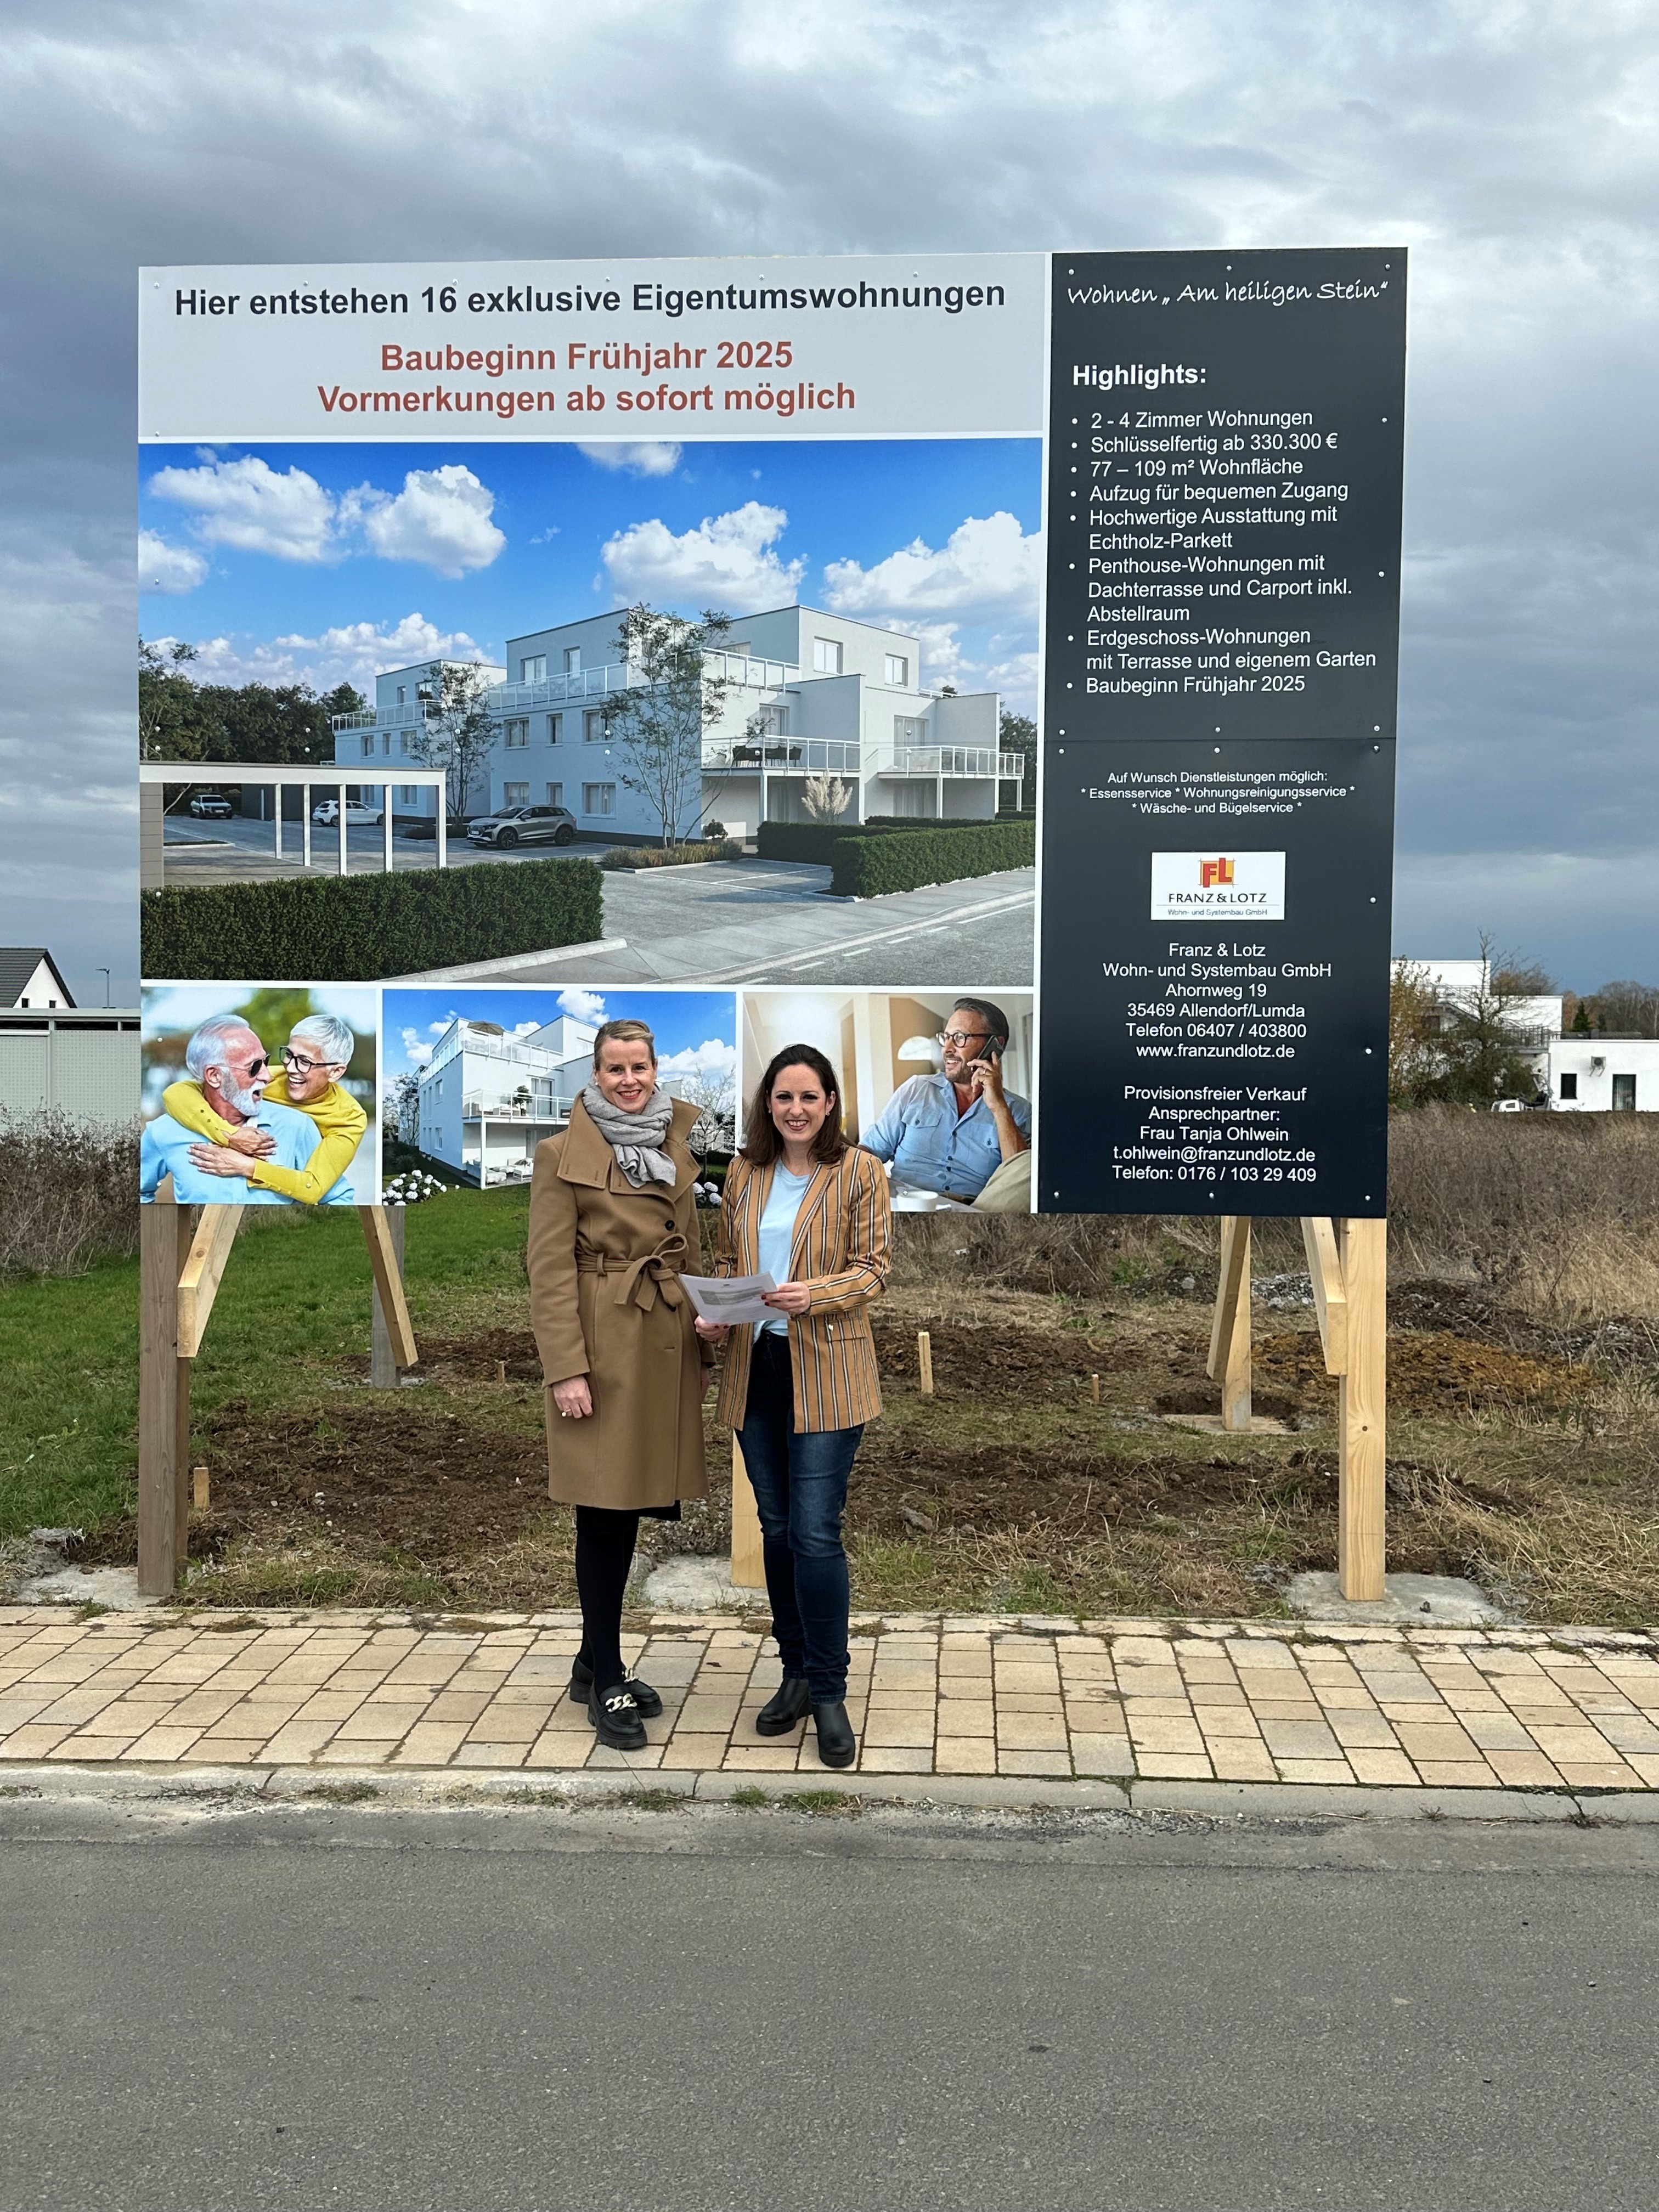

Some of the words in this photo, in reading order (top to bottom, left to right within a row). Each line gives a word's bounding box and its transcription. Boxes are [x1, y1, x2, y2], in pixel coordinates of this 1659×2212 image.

[177, 290, 240, 315] Hier
[250, 288, 408, 314] entstehen
[422, 287, 456, 312] 16
[469, 285, 620, 312] exklusive
[634, 281, 1004, 317] Eigentumswohnungen
[1068, 285, 1157, 303] Wohnen
[1177, 285, 1218, 301] Am
[1226, 281, 1312, 306] heiligen
[382, 344, 555, 377] Baubeginn
[569, 342, 707, 376] Frühjahr
[717, 342, 792, 368] 2025
[1074, 364, 1205, 390] Highlights:
[318, 386, 554, 418] Vormerkungen
[567, 385, 605, 411] ab
[617, 384, 713, 410] sofort
[725, 382, 854, 416] möglich
[1092, 413, 1101, 428] 2
[1119, 413, 1130, 427] 4
[1136, 412, 1203, 427] Zimmer
[1207, 410, 1312, 429] Wohnungen
[1091, 435, 1217, 454] Schlüsselfertig
[1223, 435, 1244, 450] ab
[1251, 433, 1321, 450] 330.300
[1326, 433, 1338, 448] €
[1091, 462, 1111, 477] 77
[1135, 460, 1166, 476] 109
[1172, 460, 1194, 475] m²
[1200, 458, 1302, 475] Wohnfläche
[1090, 485, 1150, 504] Aufzug
[1156, 484, 1179, 500] für
[1185, 484, 1276, 503] bequemen
[1282, 482, 1347, 501] Zugang
[1091, 509, 1197, 528] Hochwertige
[1201, 507, 1305, 526] Ausstattung
[1312, 506, 1337, 521] mit
[1090, 532, 1232, 549] Echtholz-Parkett
[1090, 556, 1292, 575] Penthouse-Wohnungen
[1299, 555, 1324, 570] mit
[1089, 582, 1203, 597] Dachterrasse
[1210, 580, 1240, 596] und
[1247, 580, 1312, 599] Carport
[1318, 578, 1351, 594] inkl.
[1087, 606, 1189, 622] Abstellraum
[1088, 628, 1310, 649] Erdgeschoss-Wohnungen
[1087, 654, 1112, 669] mit
[1118, 654, 1192, 669] Terrasse
[1198, 652, 1229, 668] und
[1235, 652, 1310, 672] eigenem
[1317, 651, 1375, 666] Garten
[1087, 678, 1177, 696] Baubeginn
[1184, 676, 1257, 696] Frühjahr
[1261, 676, 1305, 691] 2025
[1108, 772, 1128, 783] Auf
[1131, 772, 1177, 782] Wunsch
[1181, 772, 1275, 784] Dienstleistungen
[1279, 771, 1327, 783] möglich:
[1090, 788, 1171, 798] Essensservice
[1183, 787, 1346, 799] Wohnungsreinigungsservice
[1140, 803, 1191, 813] Wäsche-
[1195, 803, 1215, 813] und
[1220, 802, 1293, 815] Bügelservice
[1169, 894, 1214, 902] FRANZ
[1217, 894, 1227, 902] &
[1231, 894, 1266, 902] LOTZ
[1170, 943, 1212, 956] Franz
[1217, 943, 1228, 956] &
[1234, 943, 1266, 956] Lotz
[1103, 963, 1153, 976] Wohn-
[1158, 963, 1185, 976] und
[1191, 963, 1276, 980] Systembau
[1282, 963, 1331, 977] GmbH
[1166, 984, 1242, 1000] Ahornweg
[1249, 984, 1266, 997] 19
[1128, 1003, 1175, 1017] 35469
[1179, 1003, 1305, 1017] Allendorf/Lumda
[1126, 1023, 1182, 1036] Telefon
[1188, 1024, 1234, 1037] 06407
[1239, 1023, 1245, 1037] /
[1249, 1024, 1306, 1037] 403800
[1137, 1043, 1295, 1057] www.franzundlotz.de
[1125, 1086, 1242, 1100] Provisionsfreier
[1246, 1087, 1307, 1101] Verkauf
[1149, 1107, 1279, 1123] Ansprechpartner:
[1141, 1126, 1174, 1139] Frau
[1180, 1126, 1221, 1143] Tanja
[1227, 1127, 1288, 1141] Ohlwein
[1114, 1146, 1315, 1163] t.ohlwein@franzundlotz.de
[1112, 1165, 1172, 1179] Telefon:
[1178, 1167, 1216, 1180] 0176
[1220, 1166, 1226, 1181] /
[1231, 1167, 1258, 1181] 103
[1263, 1167, 1282, 1181] 29
[1287, 1168, 1316, 1182] 409
